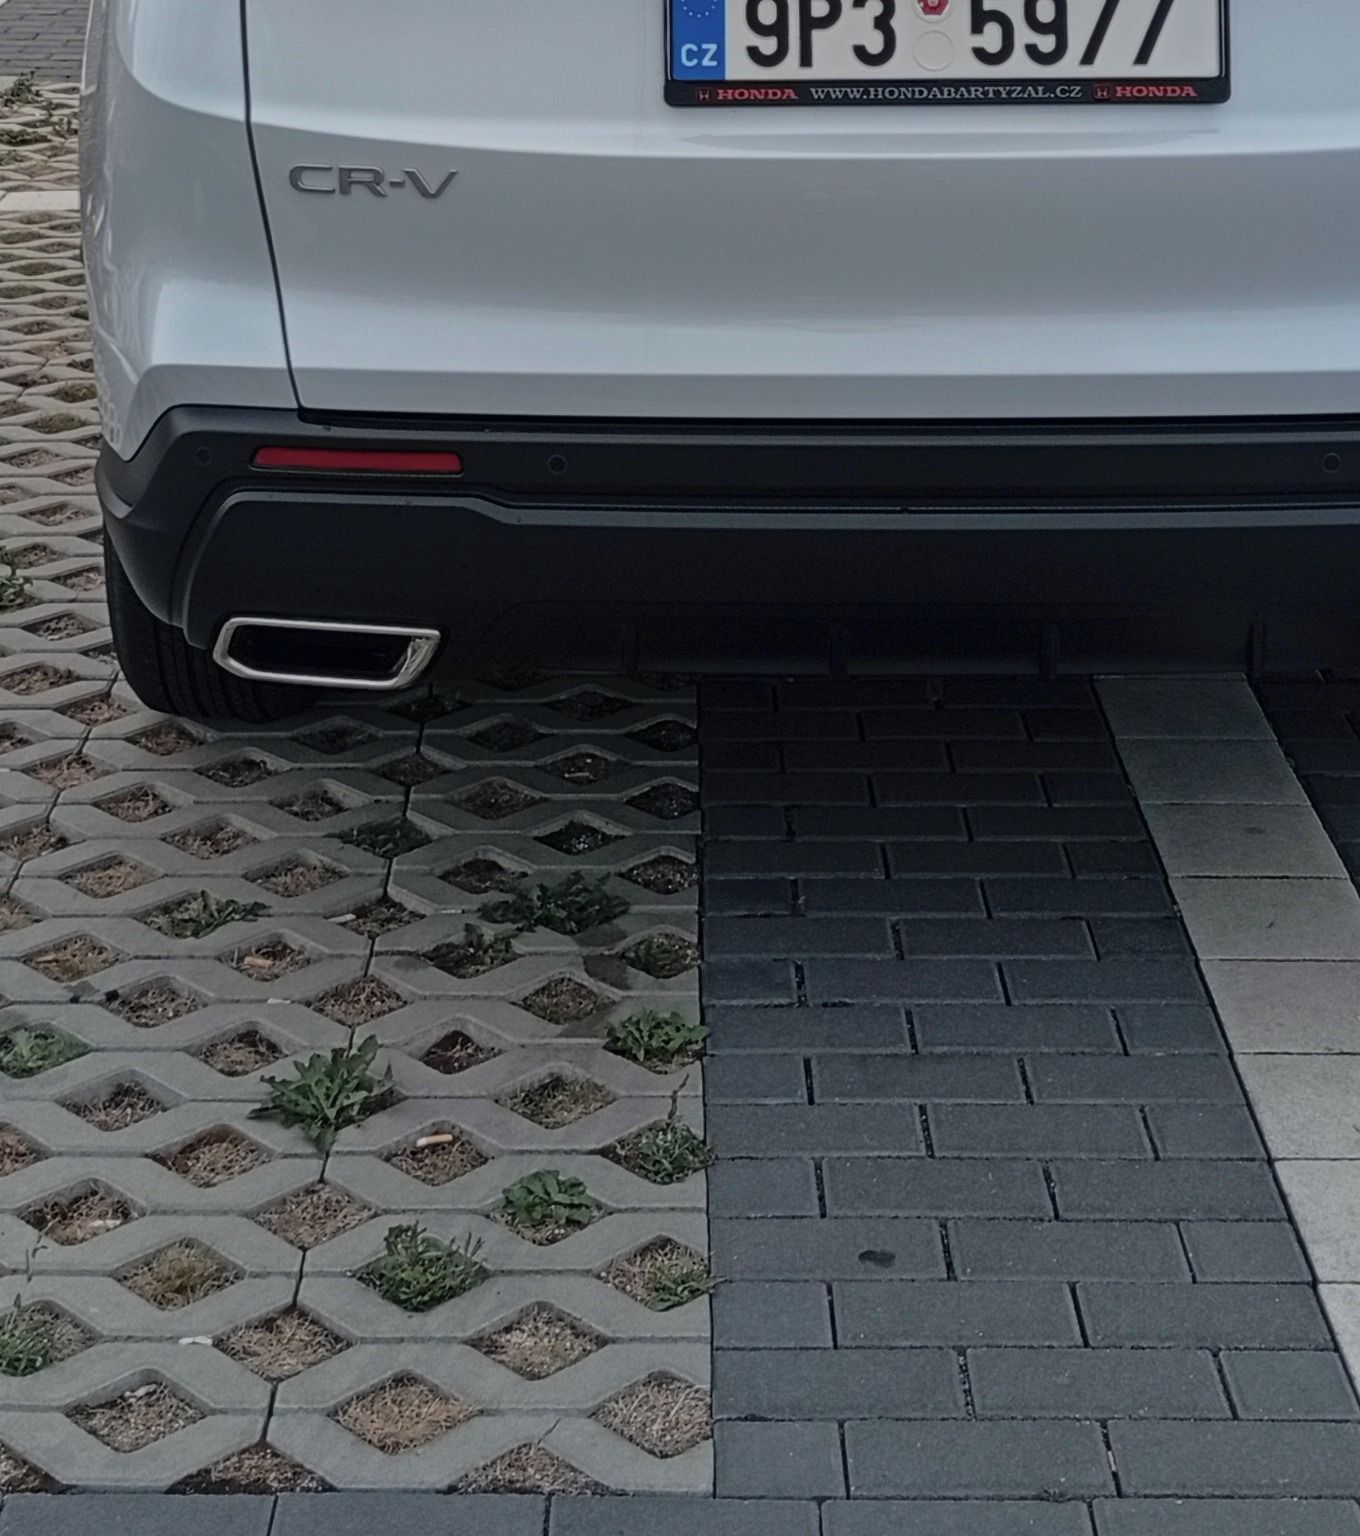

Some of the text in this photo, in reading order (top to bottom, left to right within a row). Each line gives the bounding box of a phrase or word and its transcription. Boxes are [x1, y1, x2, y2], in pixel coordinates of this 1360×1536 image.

[680, 43, 718, 66] CZ
[717, 85, 1197, 100] HONDA WWW.HONDABARTYZAL.CZ HONDA
[289, 163, 459, 199] CR-V
